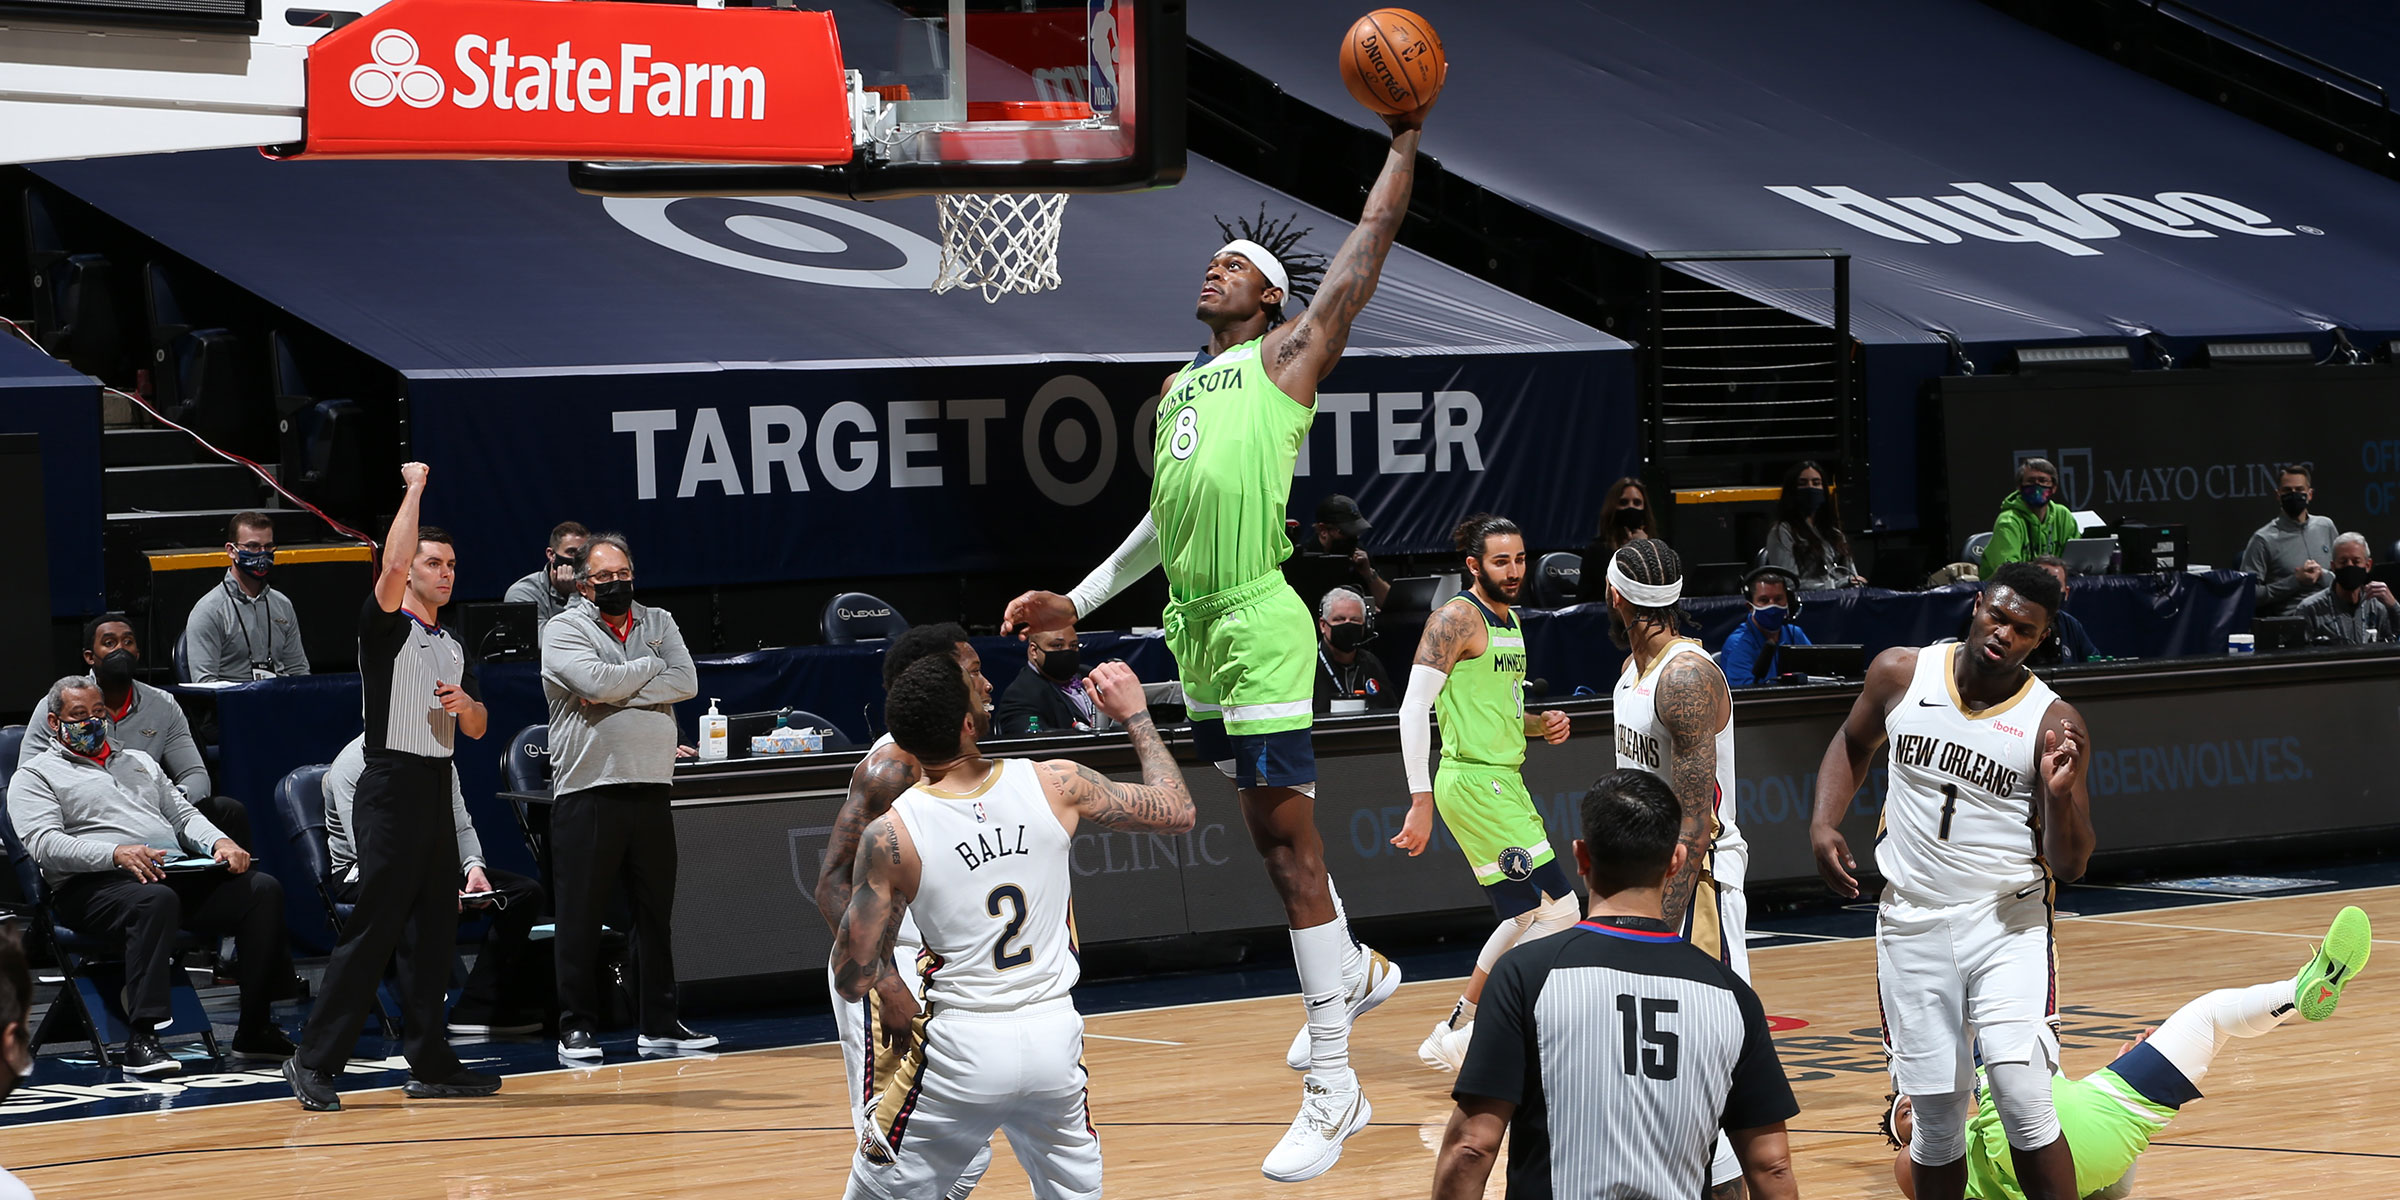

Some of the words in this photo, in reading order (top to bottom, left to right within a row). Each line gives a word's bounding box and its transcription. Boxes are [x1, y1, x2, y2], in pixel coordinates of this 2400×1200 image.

[1094, 87, 1112, 105] NBA
[1361, 35, 1410, 102] SPALDING
[611, 398, 1007, 501] TARGET
[1170, 405, 1199, 461] 8
[2104, 465, 2199, 503] MAYO
[2204, 461, 2314, 500] CLIN
[850, 608, 891, 618] LEXUS
[1993, 719, 2024, 739] ibotta
[1896, 734, 1940, 768] NEW
[1938, 741, 2018, 798] ORLEANS
[2087, 735, 2313, 797] BERWOLVES.
[1937, 782, 1958, 842] 1
[885, 821, 901, 865] CONTINUES
[955, 825, 1029, 871] BALL
[985, 882, 1034, 973] 2
[1616, 993, 1679, 1081] 15
